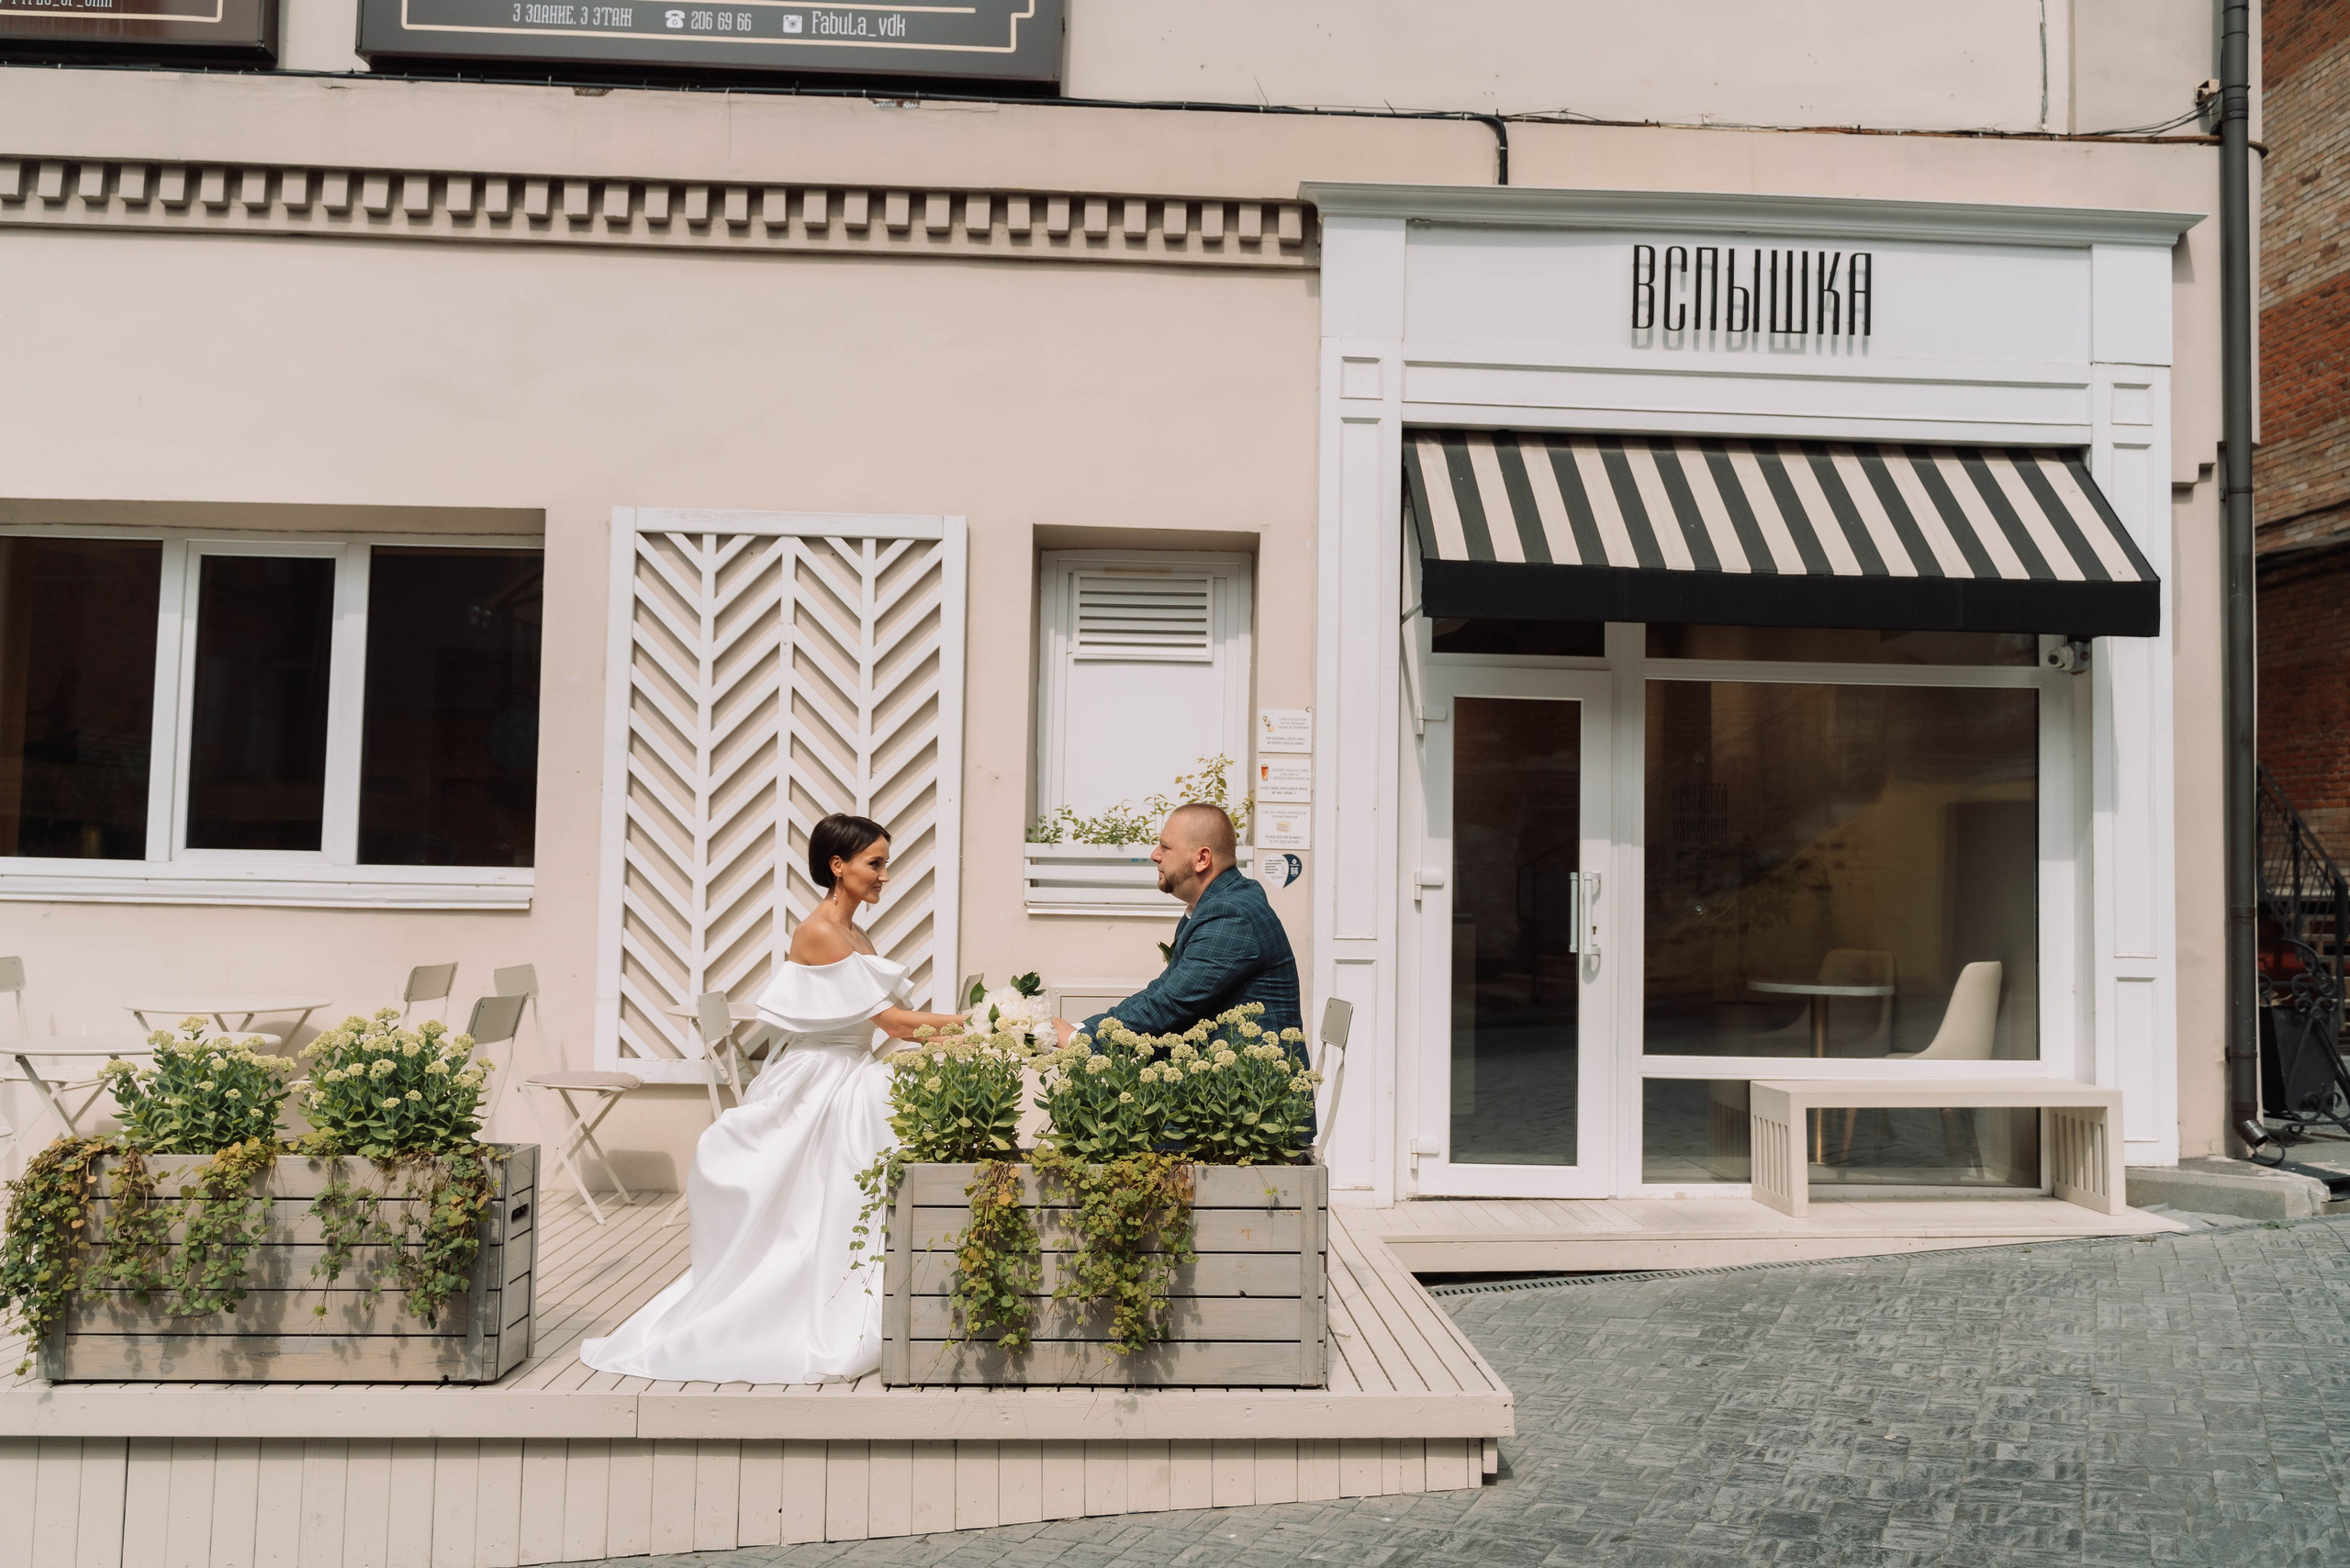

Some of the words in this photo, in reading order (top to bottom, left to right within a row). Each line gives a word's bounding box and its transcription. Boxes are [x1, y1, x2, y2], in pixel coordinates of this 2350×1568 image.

[512, 4, 521, 23] 3
[580, 6, 588, 26] 3
[593, 7, 633, 28] ЭТАЖ
[690, 10, 713, 30] 206
[717, 12, 733, 31] 69
[737, 13, 753, 32] 66
[1631, 244, 1872, 336] ВСПЫШКА
